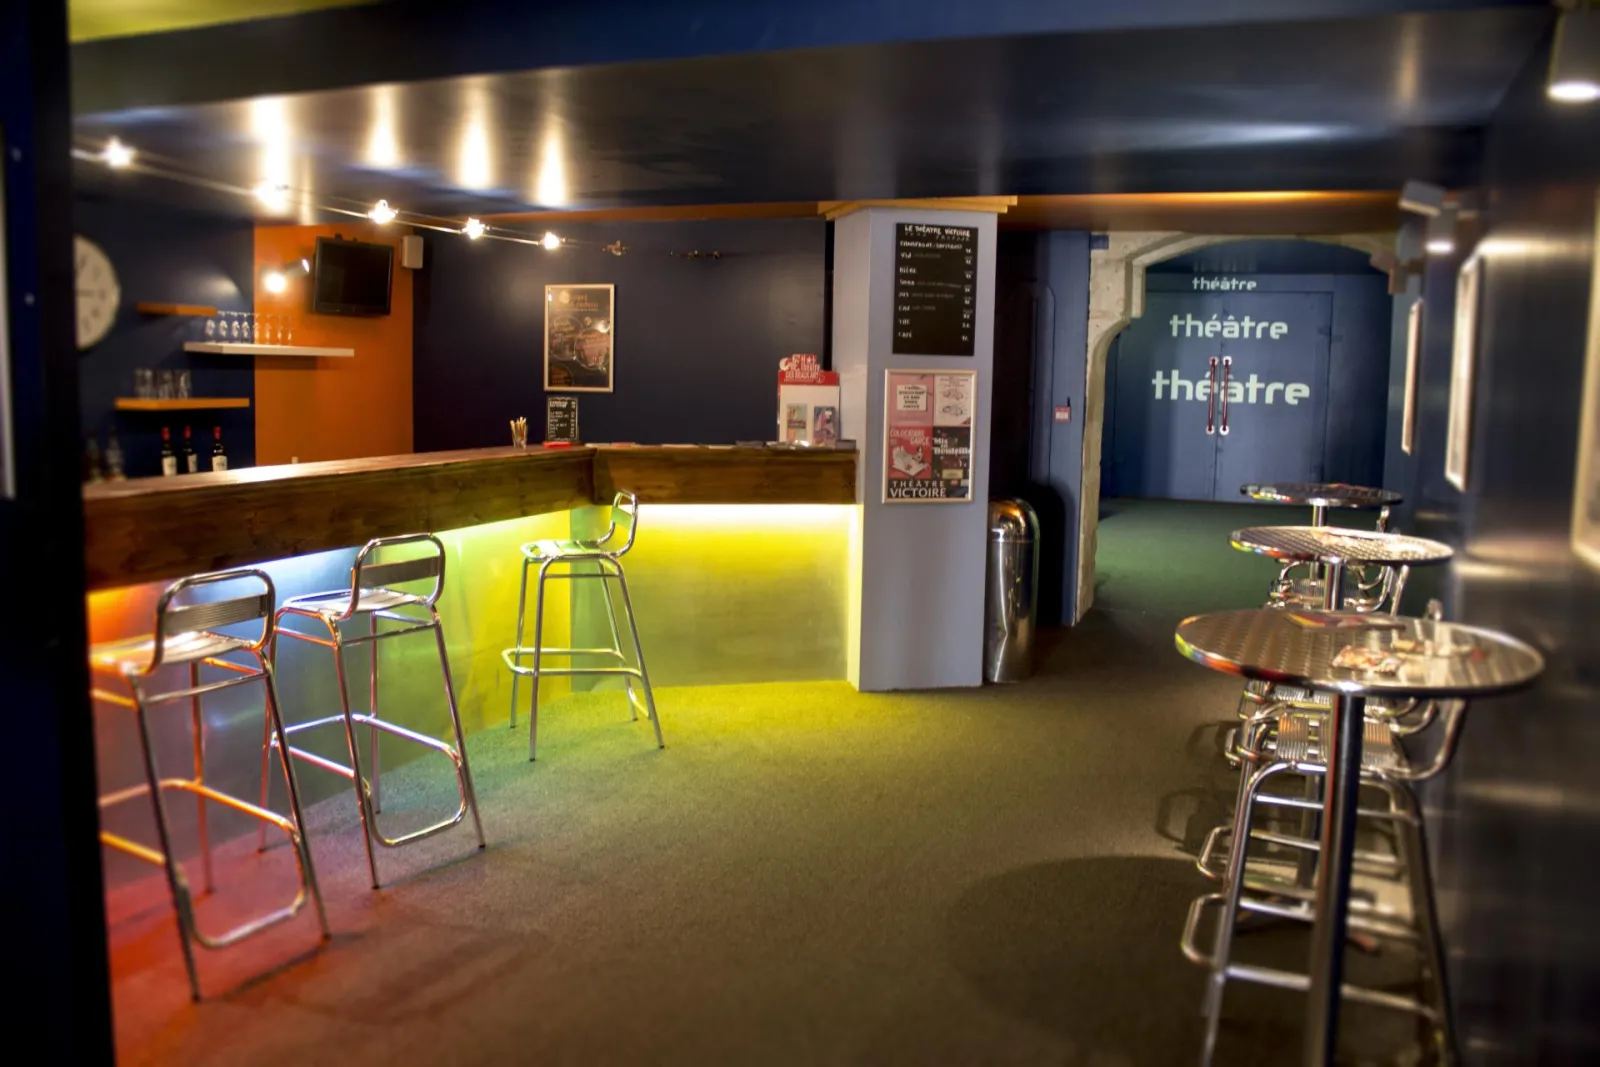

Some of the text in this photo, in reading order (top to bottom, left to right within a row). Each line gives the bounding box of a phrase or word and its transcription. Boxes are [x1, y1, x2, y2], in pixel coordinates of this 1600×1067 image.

[1192, 277, 1257, 291] théâtre
[1169, 313, 1289, 340] théâtre
[1151, 369, 1311, 406] théâtre
[890, 487, 946, 498] VICTOIRE
